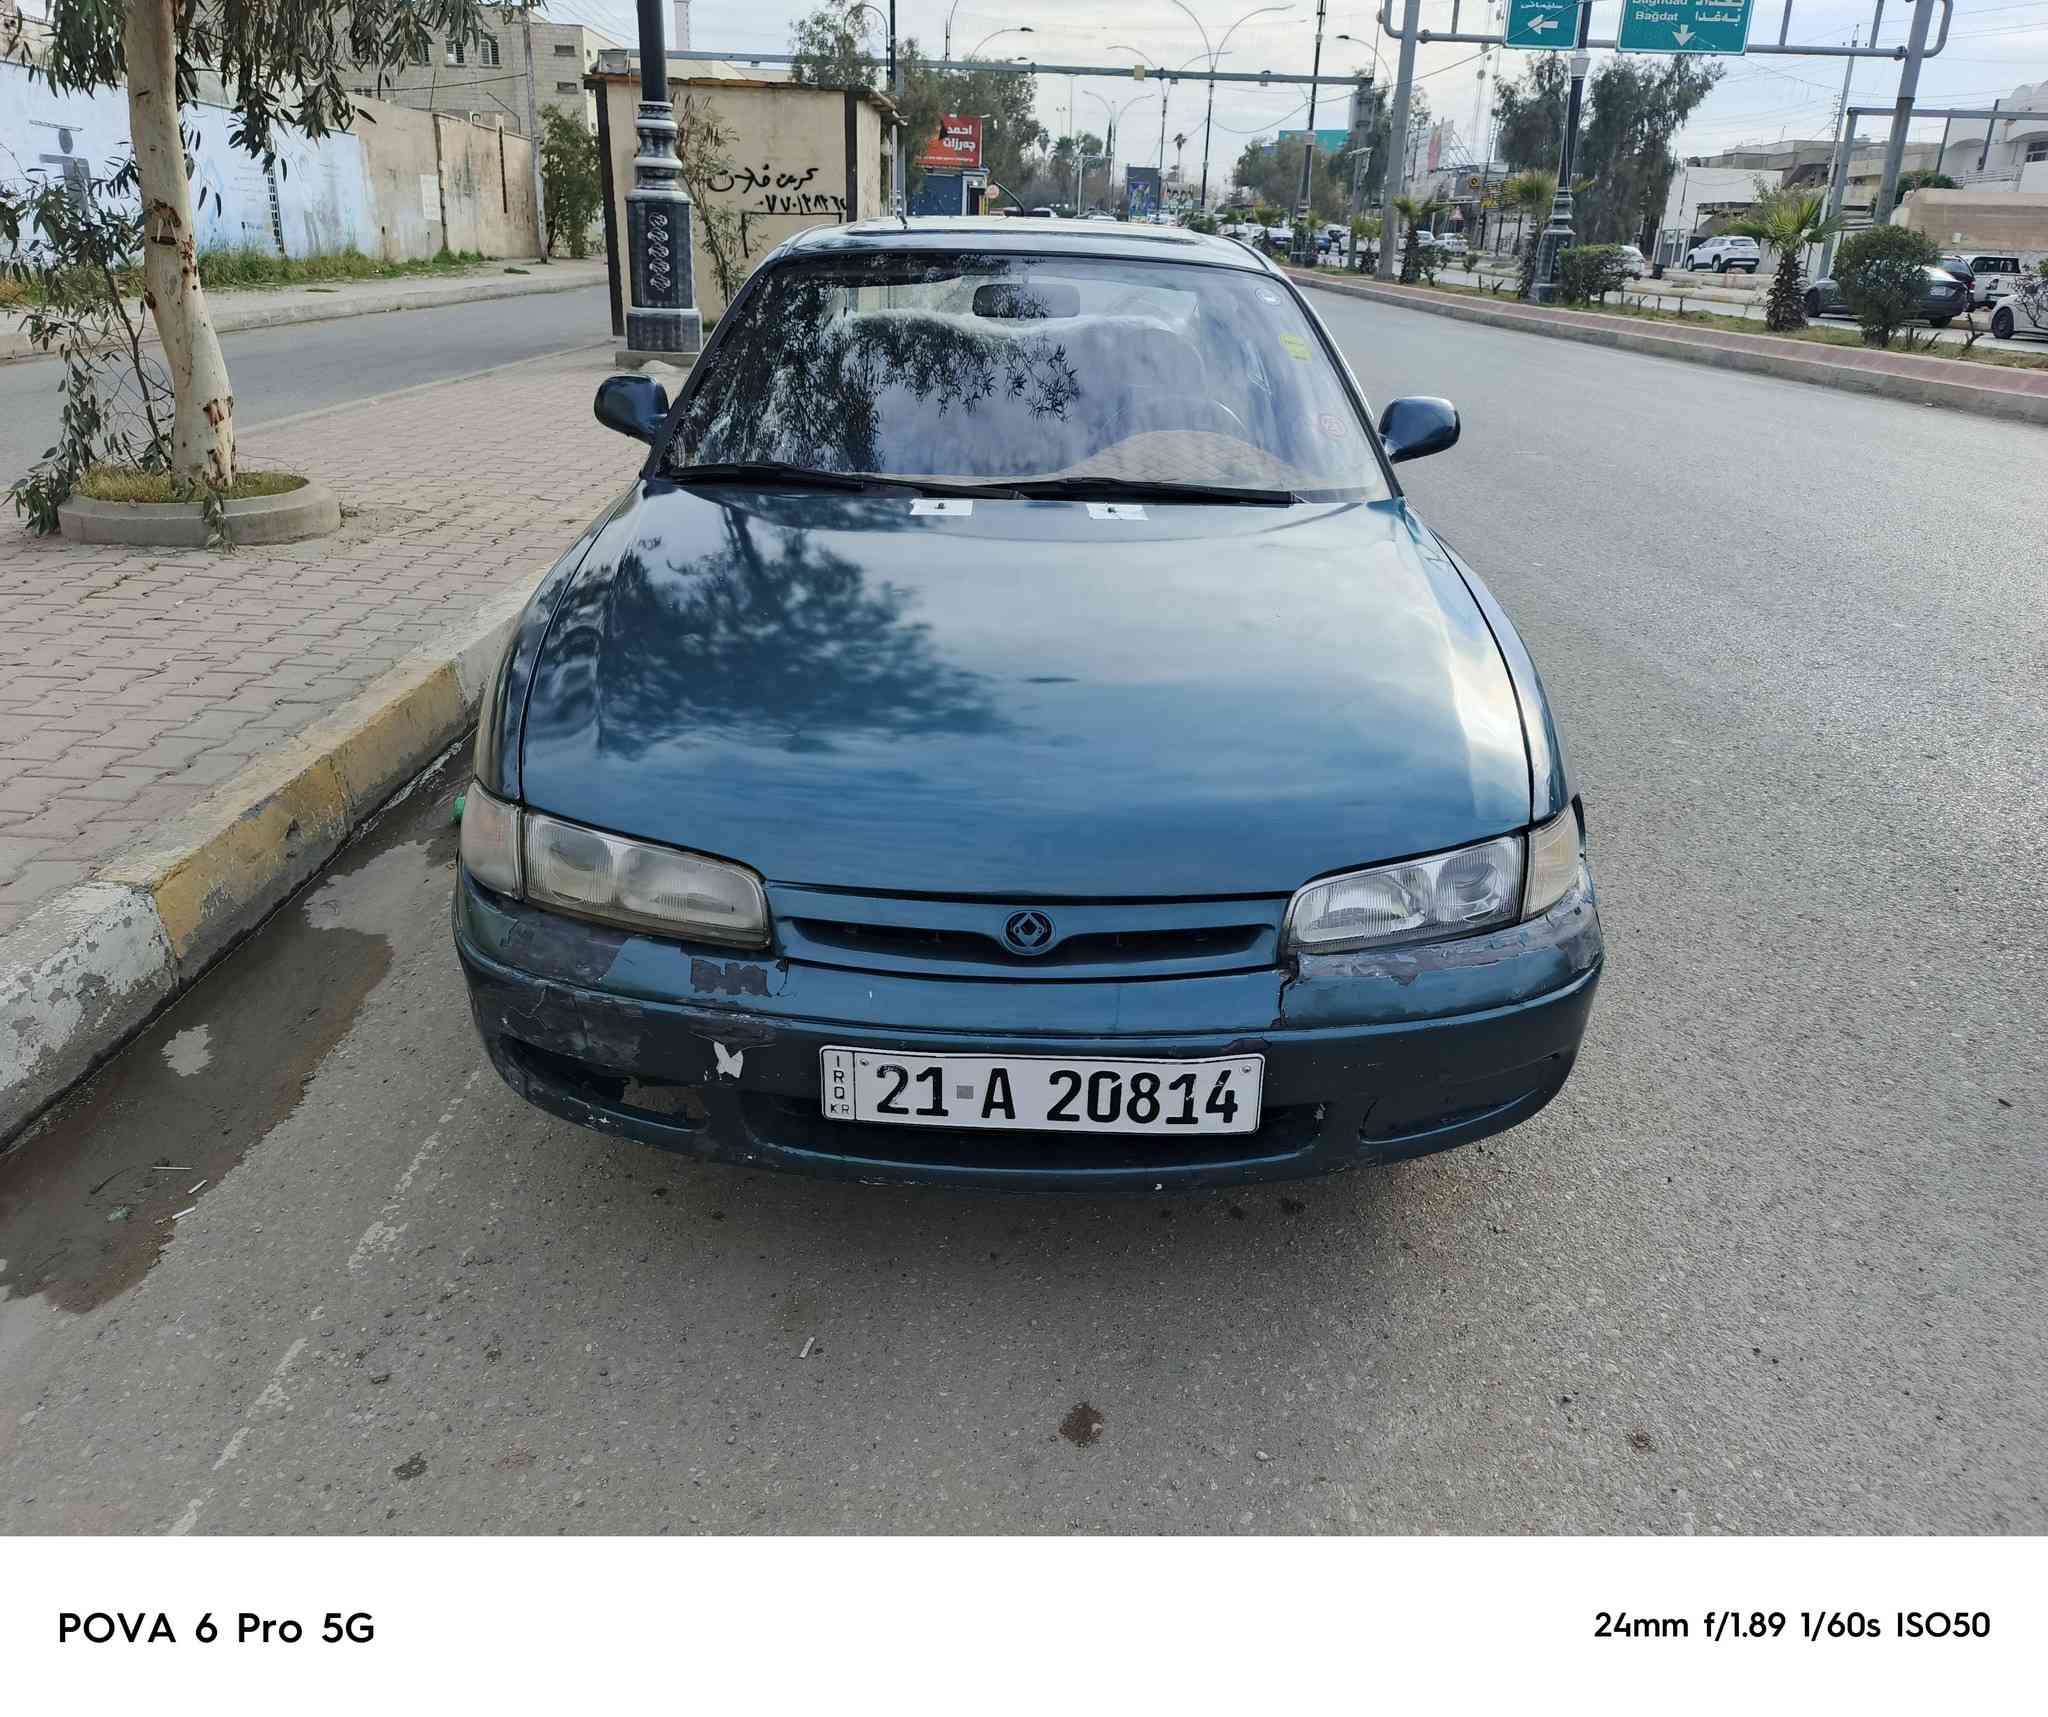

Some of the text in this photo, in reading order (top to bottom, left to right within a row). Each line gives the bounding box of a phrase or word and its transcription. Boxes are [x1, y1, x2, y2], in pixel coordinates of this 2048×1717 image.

[830, 1103, 850, 1116] KR
[876, 1064, 1238, 1124] 21 A 20814
